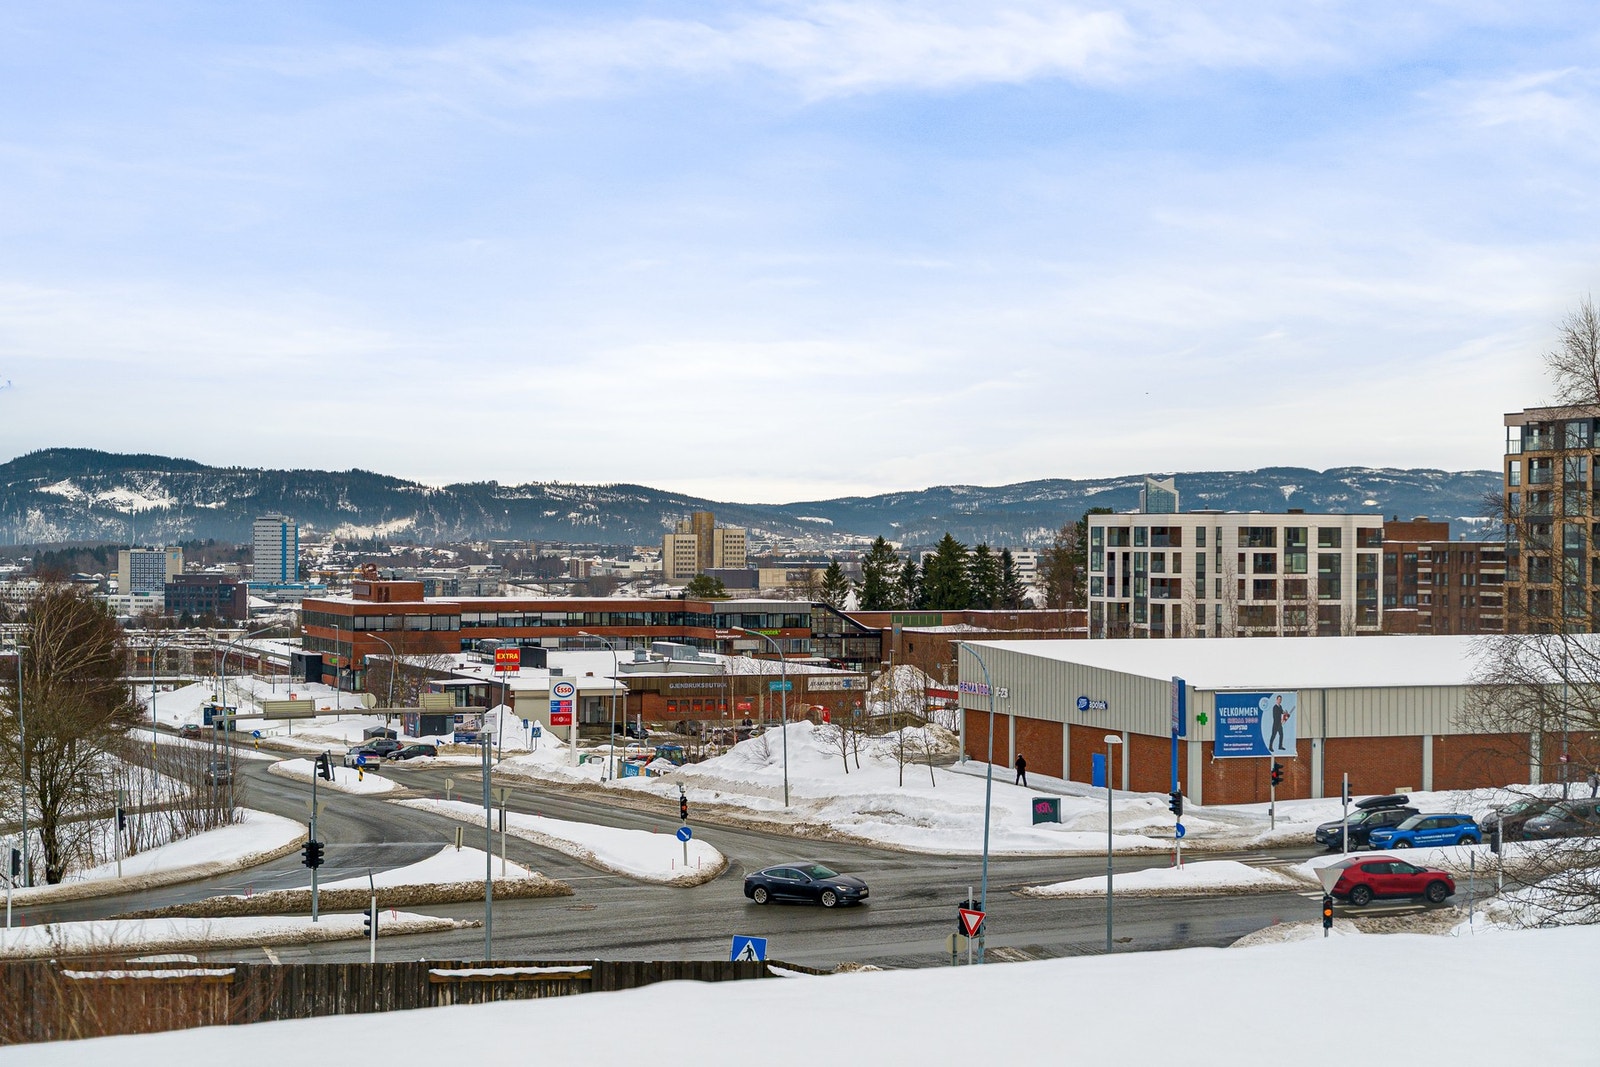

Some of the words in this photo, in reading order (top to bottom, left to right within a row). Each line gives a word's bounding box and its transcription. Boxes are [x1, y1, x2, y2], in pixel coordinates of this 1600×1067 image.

[960, 681, 978, 694] REMA
[1089, 700, 1106, 710] apotek
[1219, 707, 1258, 717] VELKOMMEN
